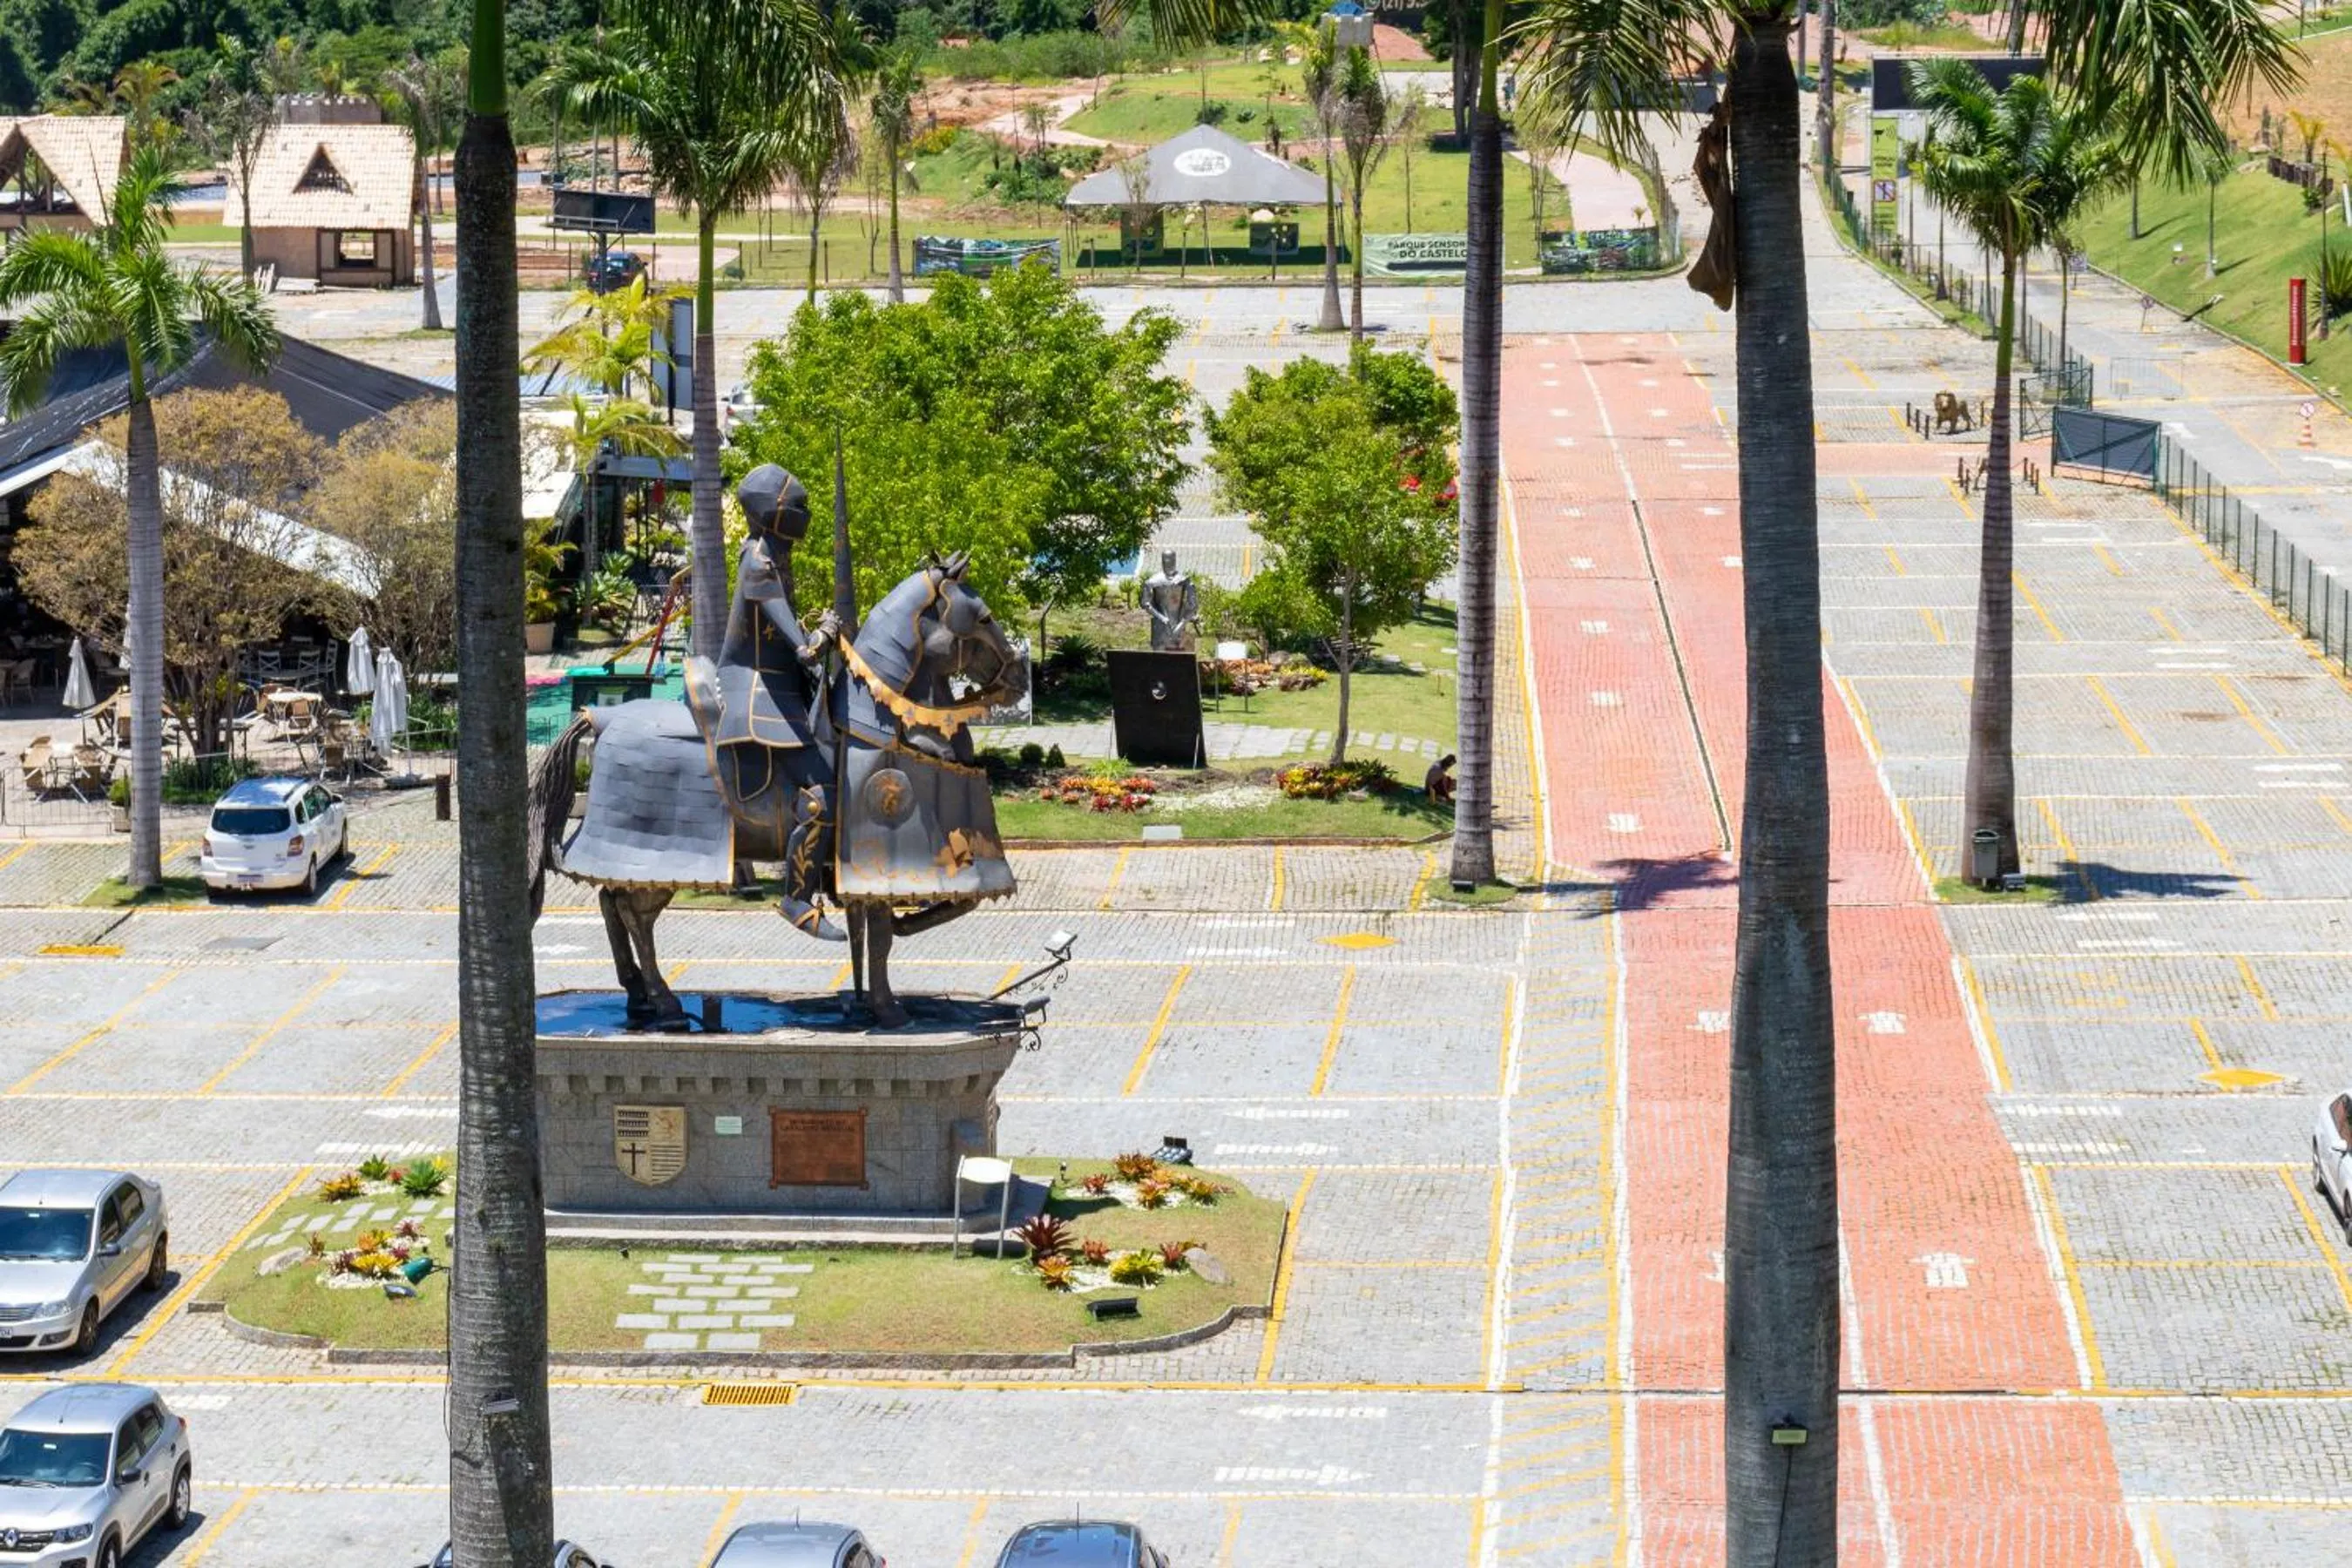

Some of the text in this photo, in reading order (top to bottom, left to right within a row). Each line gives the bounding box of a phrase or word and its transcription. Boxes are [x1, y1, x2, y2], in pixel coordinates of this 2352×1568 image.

[1388, 240, 1465, 249] PARQUE SENSOR
[1399, 249, 1416, 259] DO
